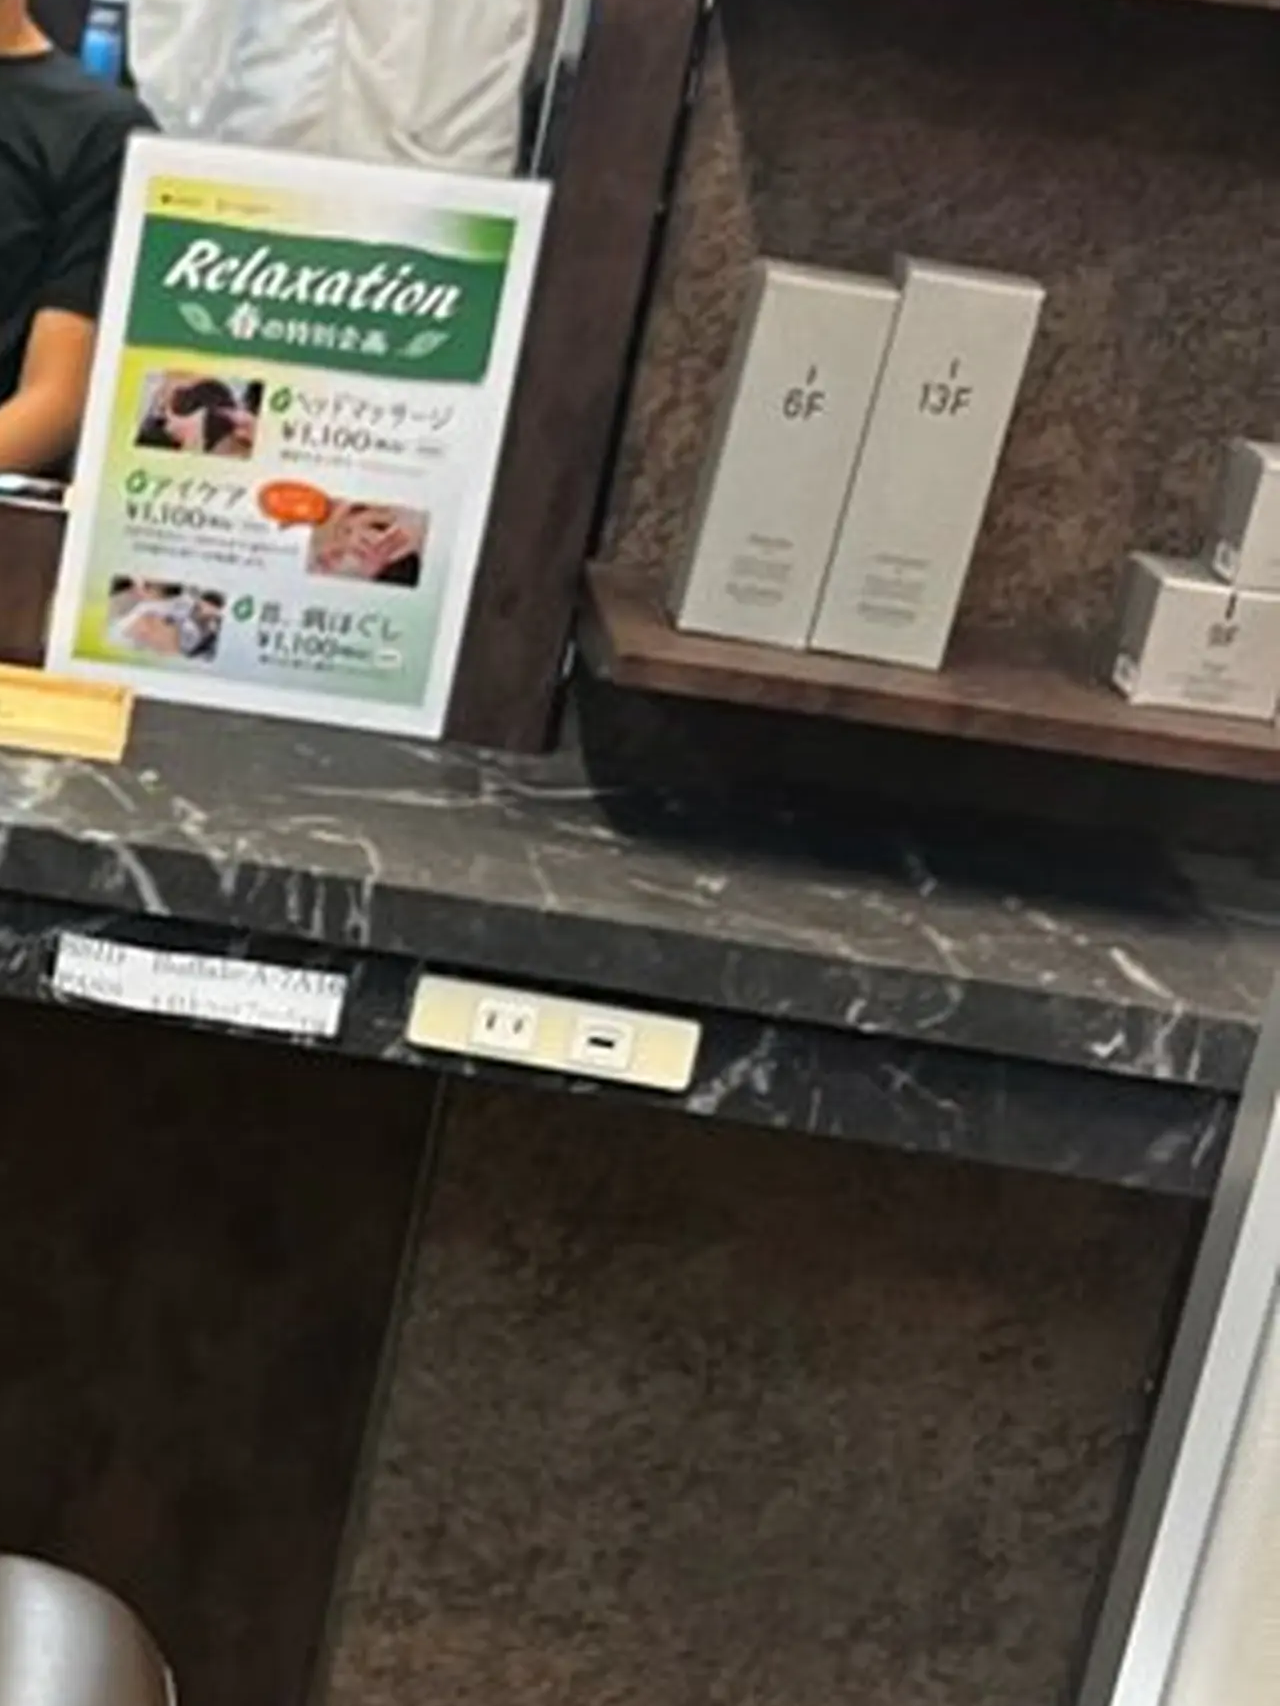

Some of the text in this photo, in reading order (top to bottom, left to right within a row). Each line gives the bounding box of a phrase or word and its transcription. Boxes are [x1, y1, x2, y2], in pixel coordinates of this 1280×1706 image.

[163, 239, 461, 320] Relaxation
[297, 390, 456, 432] ヘッドマッサージ
[782, 386, 827, 421] 6F
[919, 382, 973, 417] 13F
[153, 475, 248, 510] アイケア
